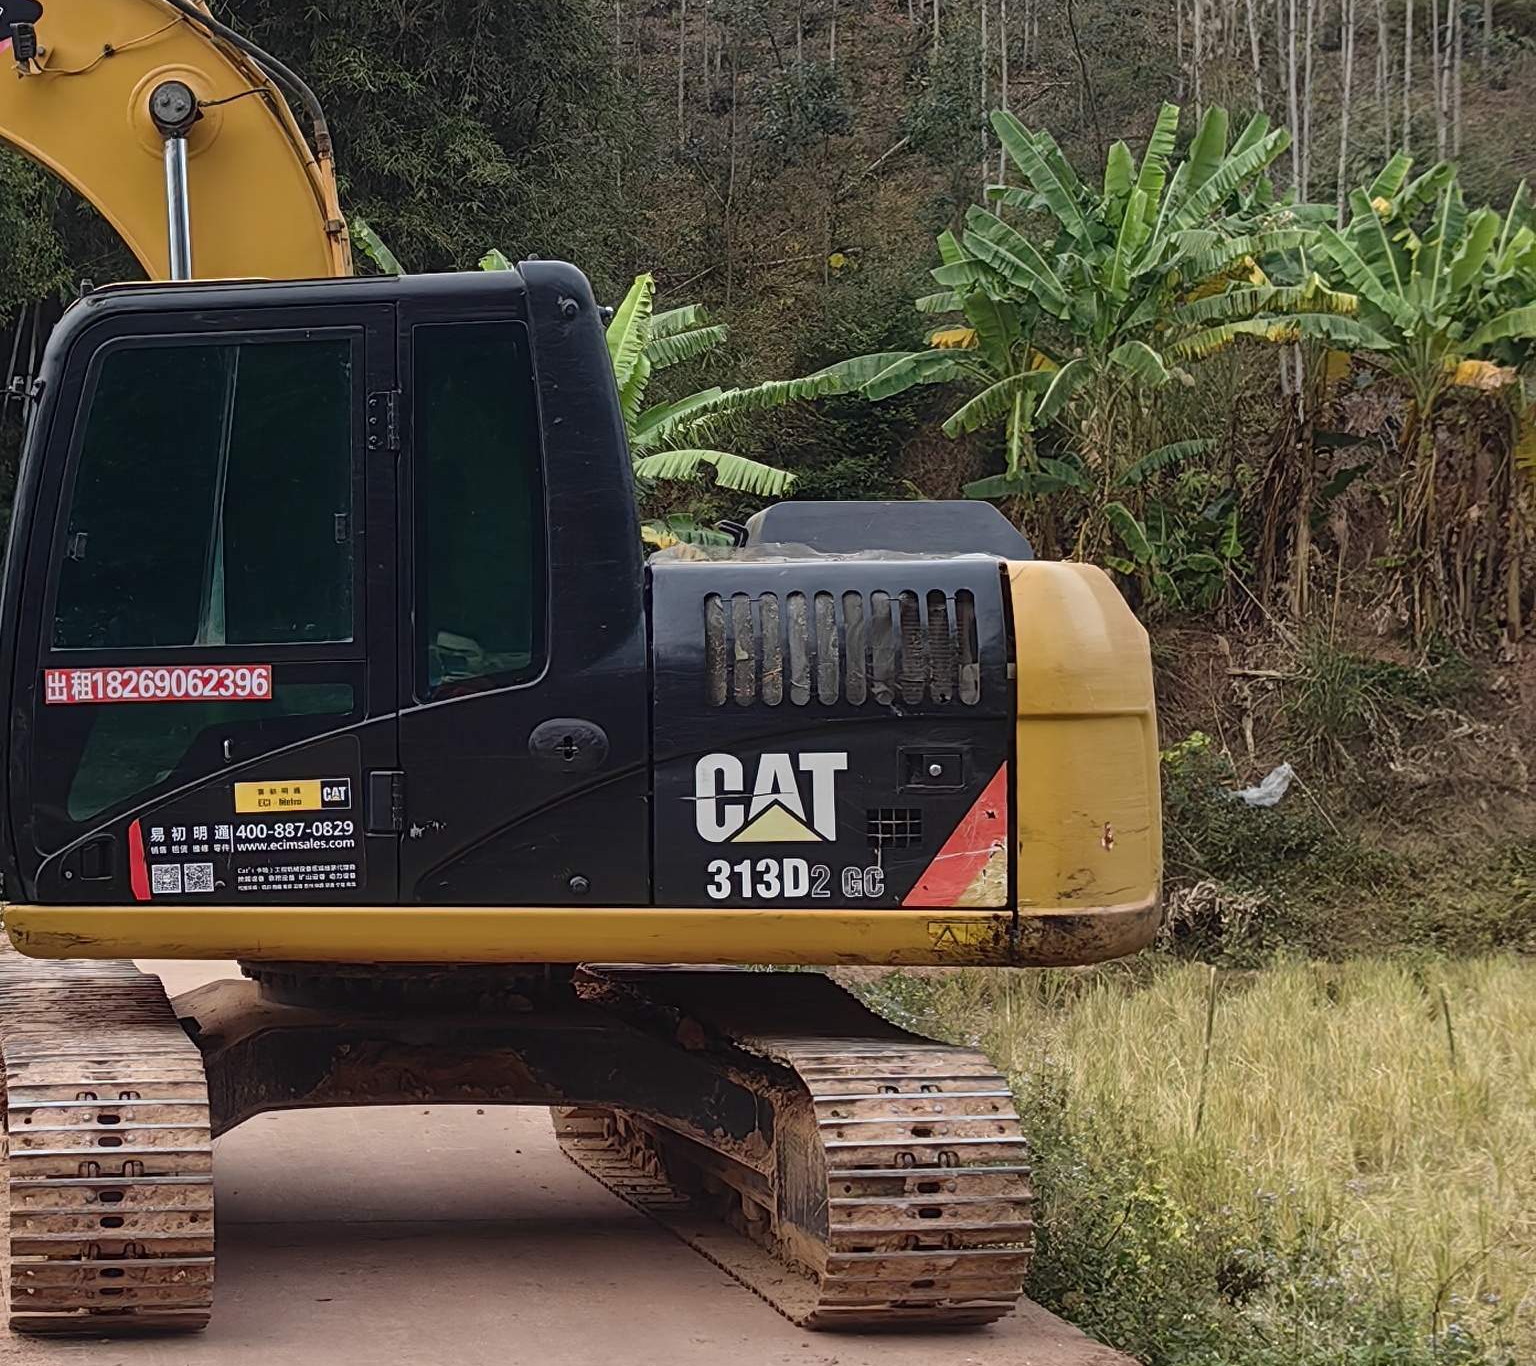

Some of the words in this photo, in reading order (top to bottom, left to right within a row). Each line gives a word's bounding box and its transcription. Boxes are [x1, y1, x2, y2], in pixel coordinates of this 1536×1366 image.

[322, 786, 347, 802] CAT
[695, 752, 848, 843] CAT
[150, 824, 230, 843] 易初明通
[235, 821, 354, 840] 400-887-0829
[236, 838, 355, 852] www.ecimsales.com
[841, 866, 885, 898] GC
